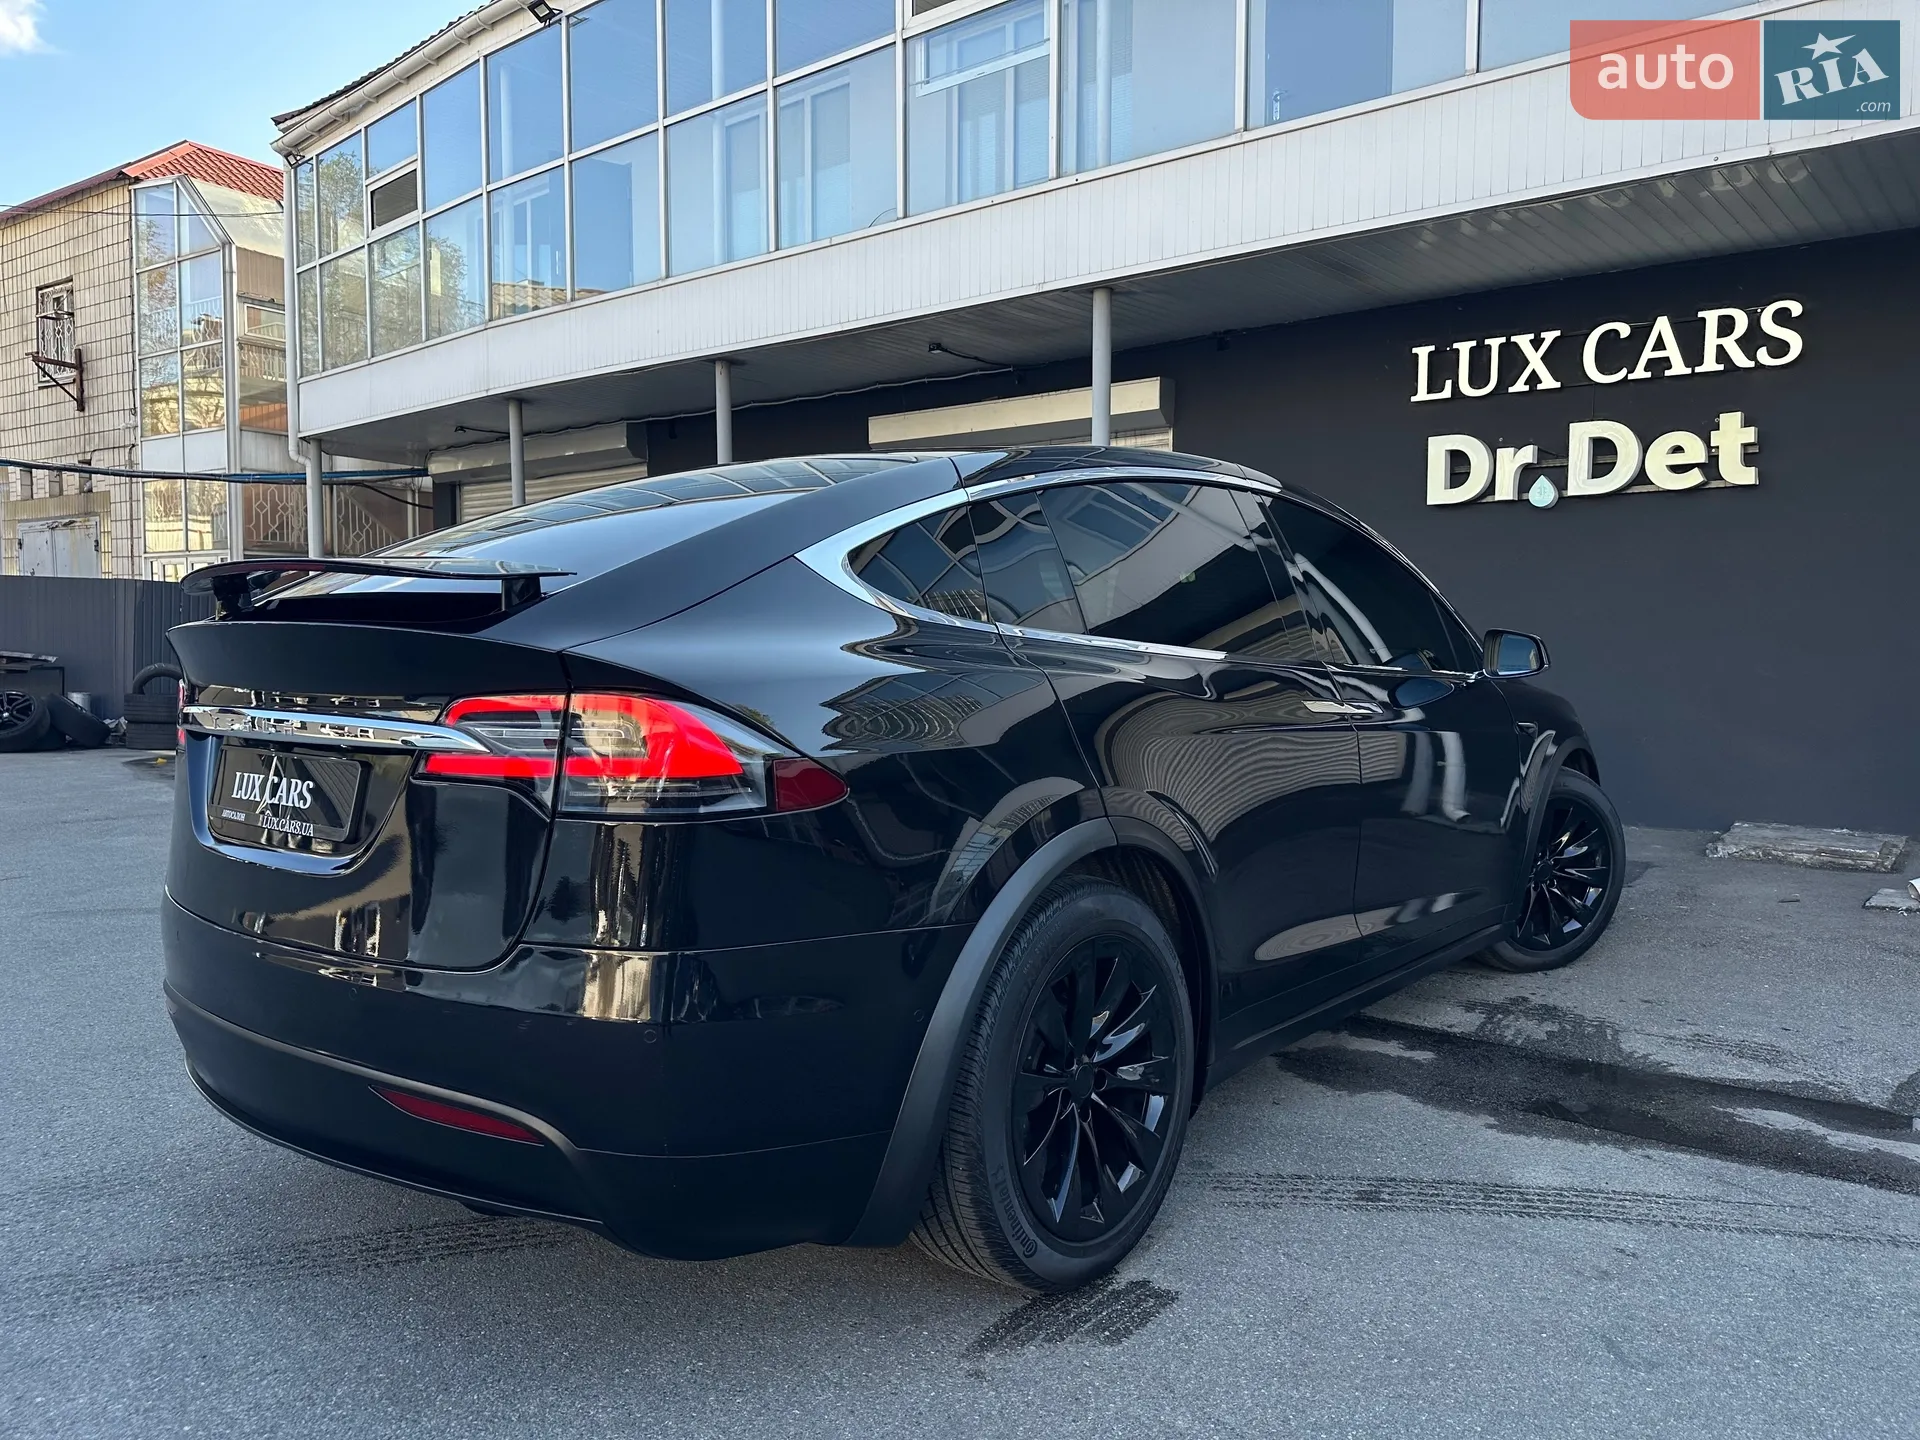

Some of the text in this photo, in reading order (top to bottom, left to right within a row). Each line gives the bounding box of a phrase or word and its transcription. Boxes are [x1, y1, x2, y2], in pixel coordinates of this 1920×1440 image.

[1410, 299, 1804, 403] LUX CARS
[231, 771, 314, 809] LUX CARS
